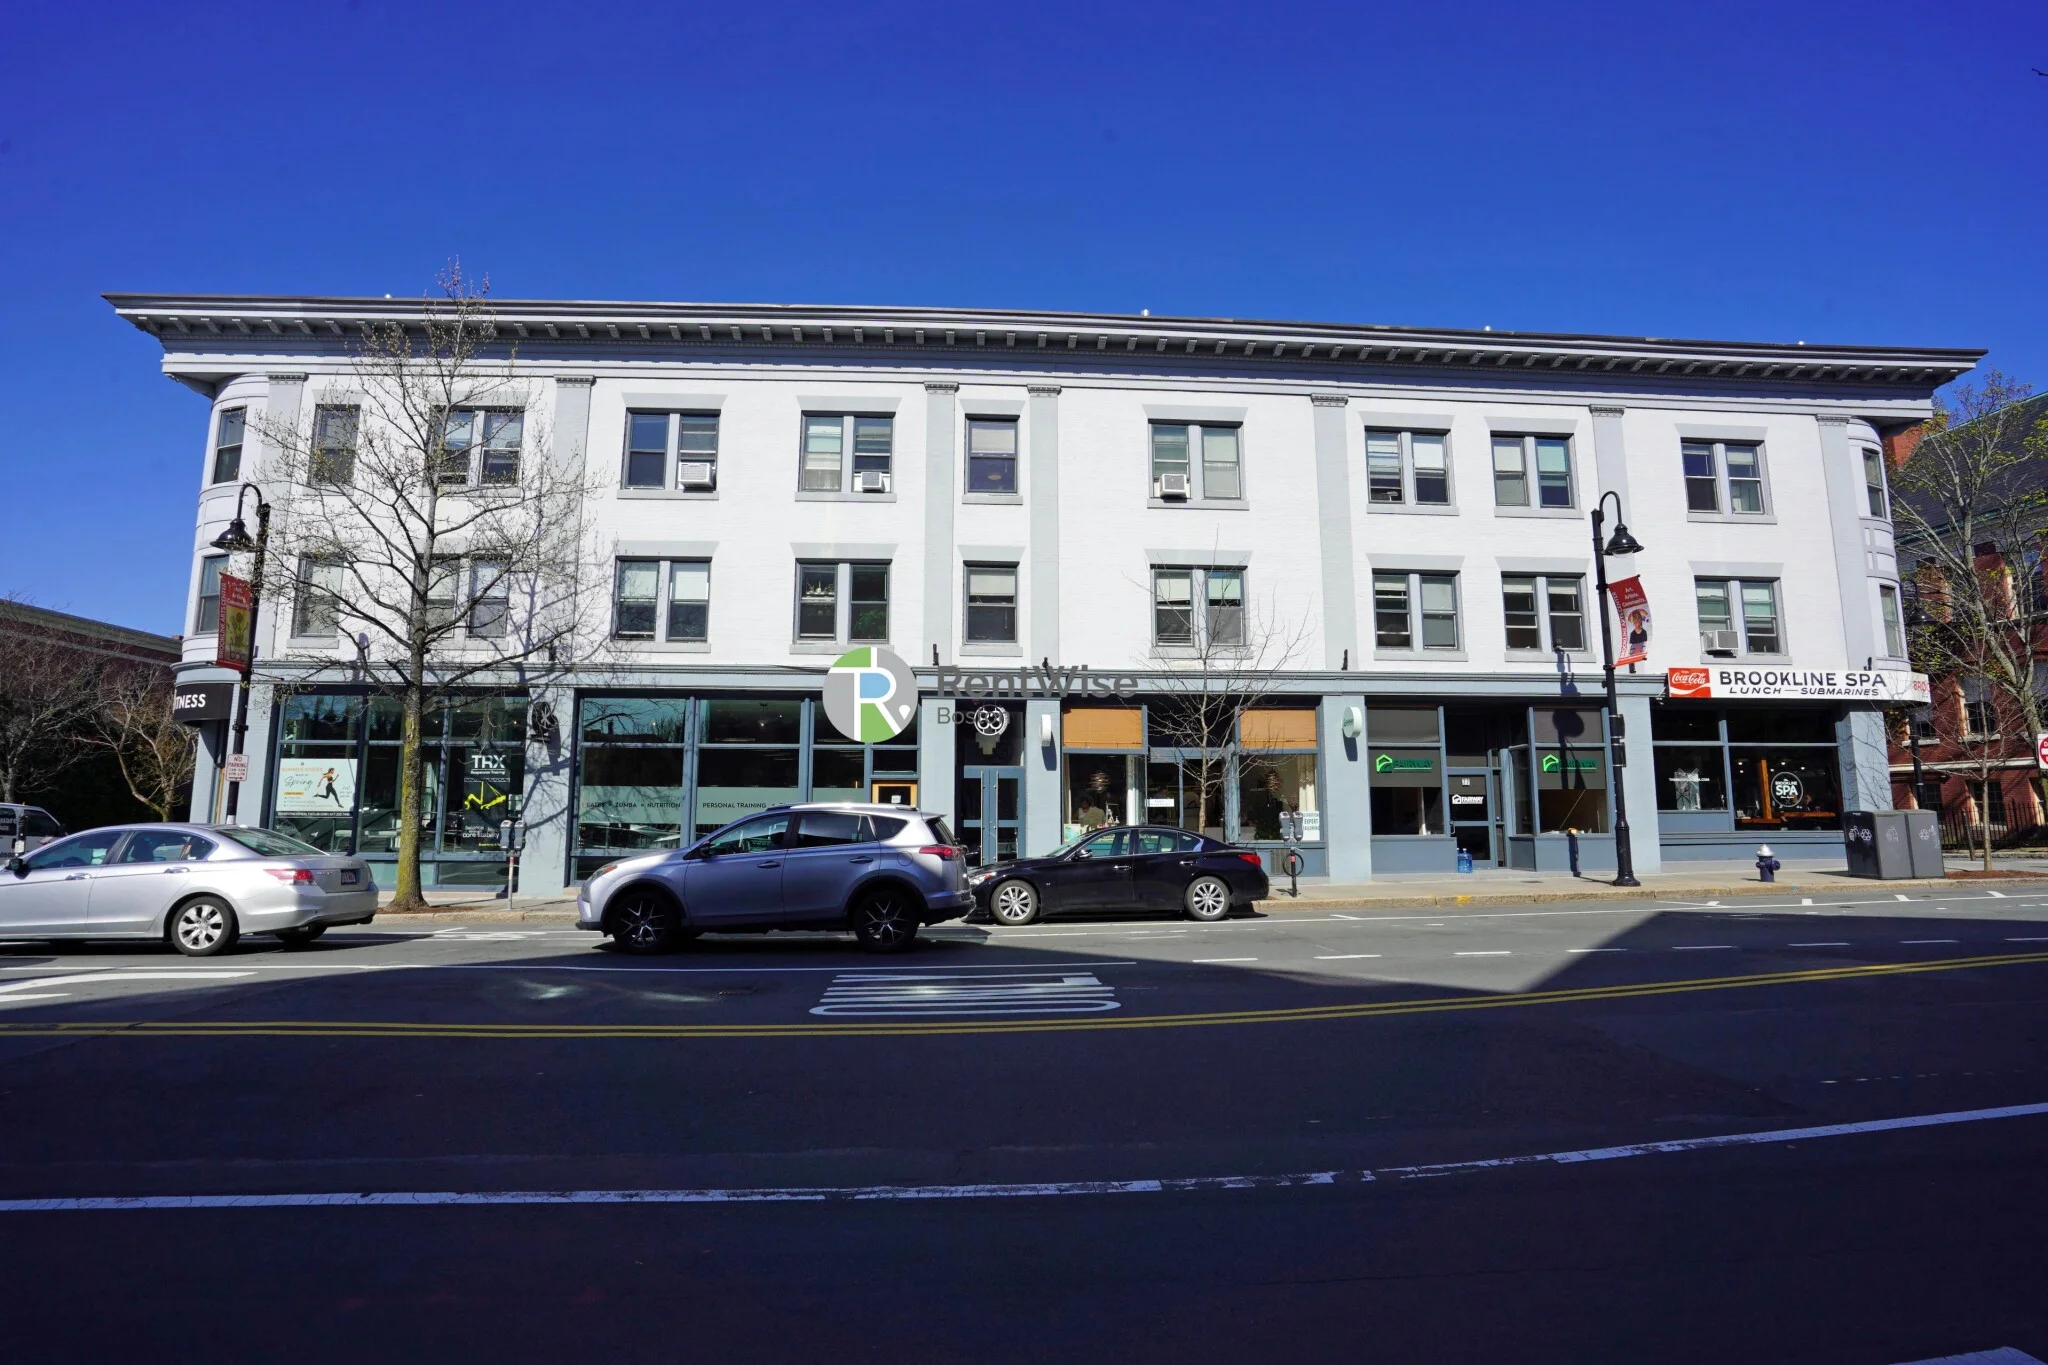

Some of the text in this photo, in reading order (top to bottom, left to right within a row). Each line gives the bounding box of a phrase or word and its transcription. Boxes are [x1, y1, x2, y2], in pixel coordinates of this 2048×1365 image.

[1671, 672, 1707, 685] Coca-Cola
[1719, 671, 1887, 687] BROOKLINE SPA
[1800, 687, 1879, 696] SUBMARINES
[471, 755, 506, 769] TRX
[1775, 784, 1799, 796] SPA
